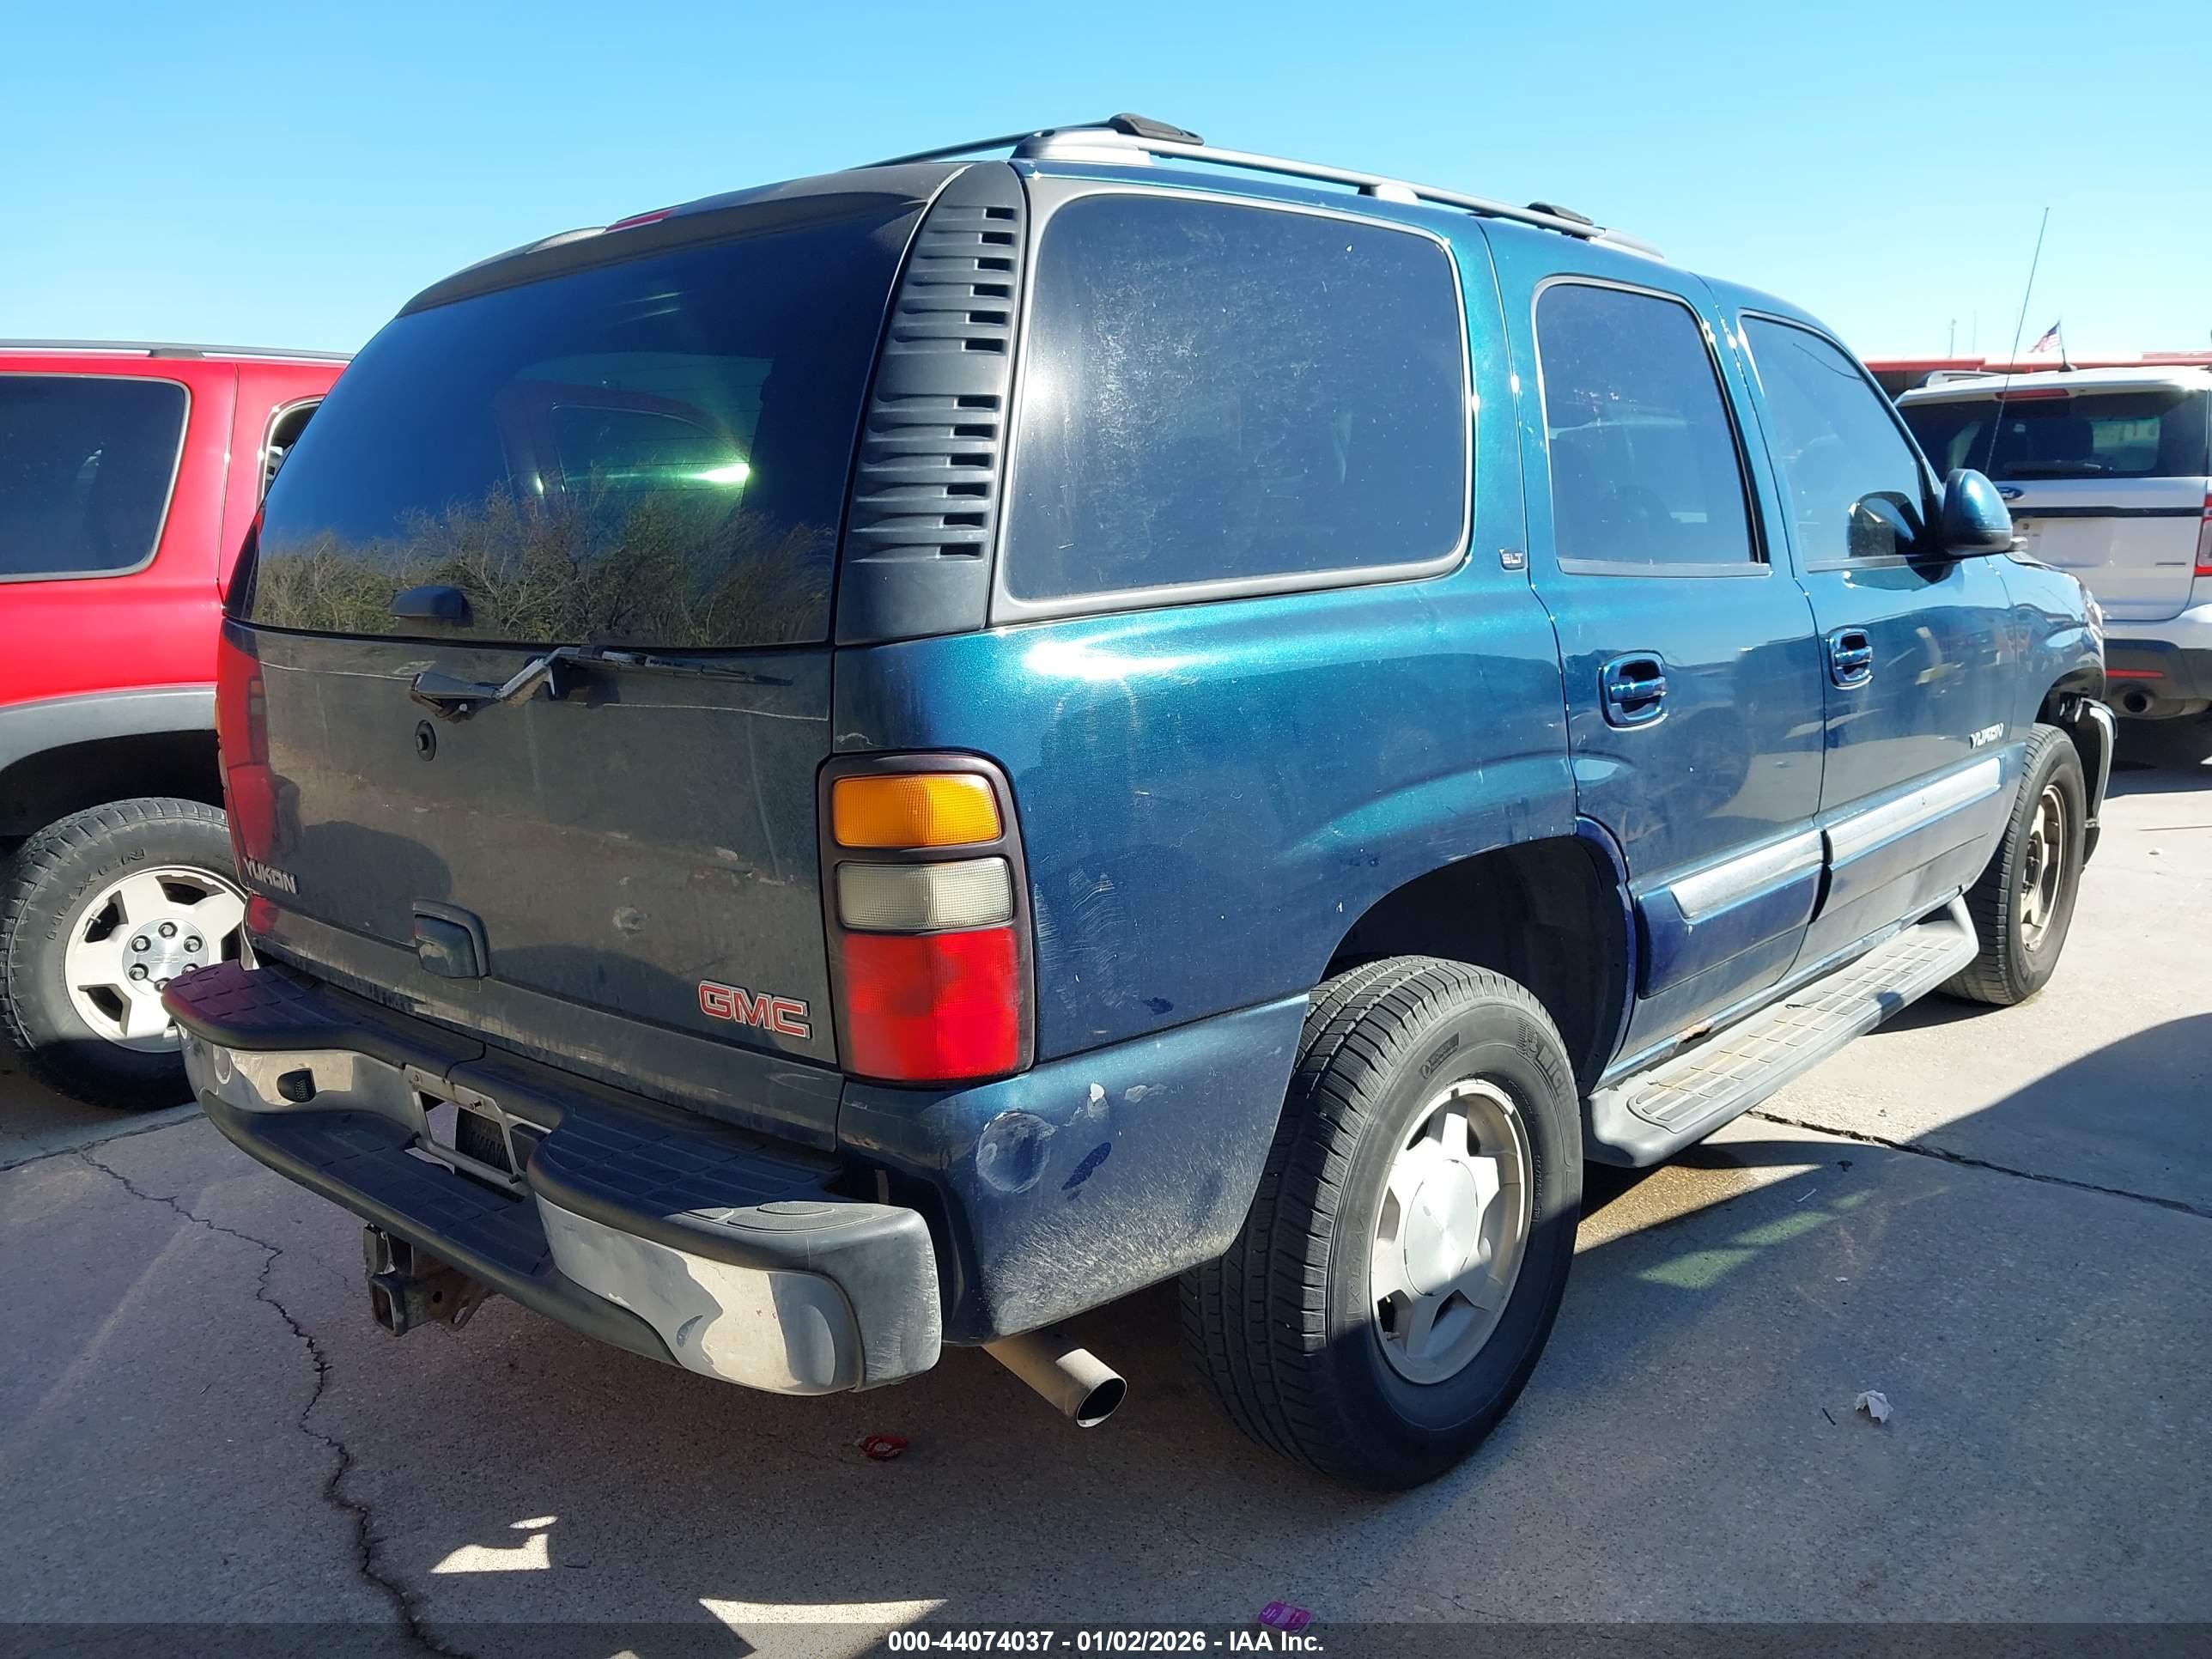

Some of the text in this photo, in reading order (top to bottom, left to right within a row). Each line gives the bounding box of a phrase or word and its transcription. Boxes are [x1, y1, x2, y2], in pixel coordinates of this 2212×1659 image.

[1968, 722, 2004, 750] YUKON
[243, 857, 297, 894] YUKON
[698, 980, 811, 1039] GMC
